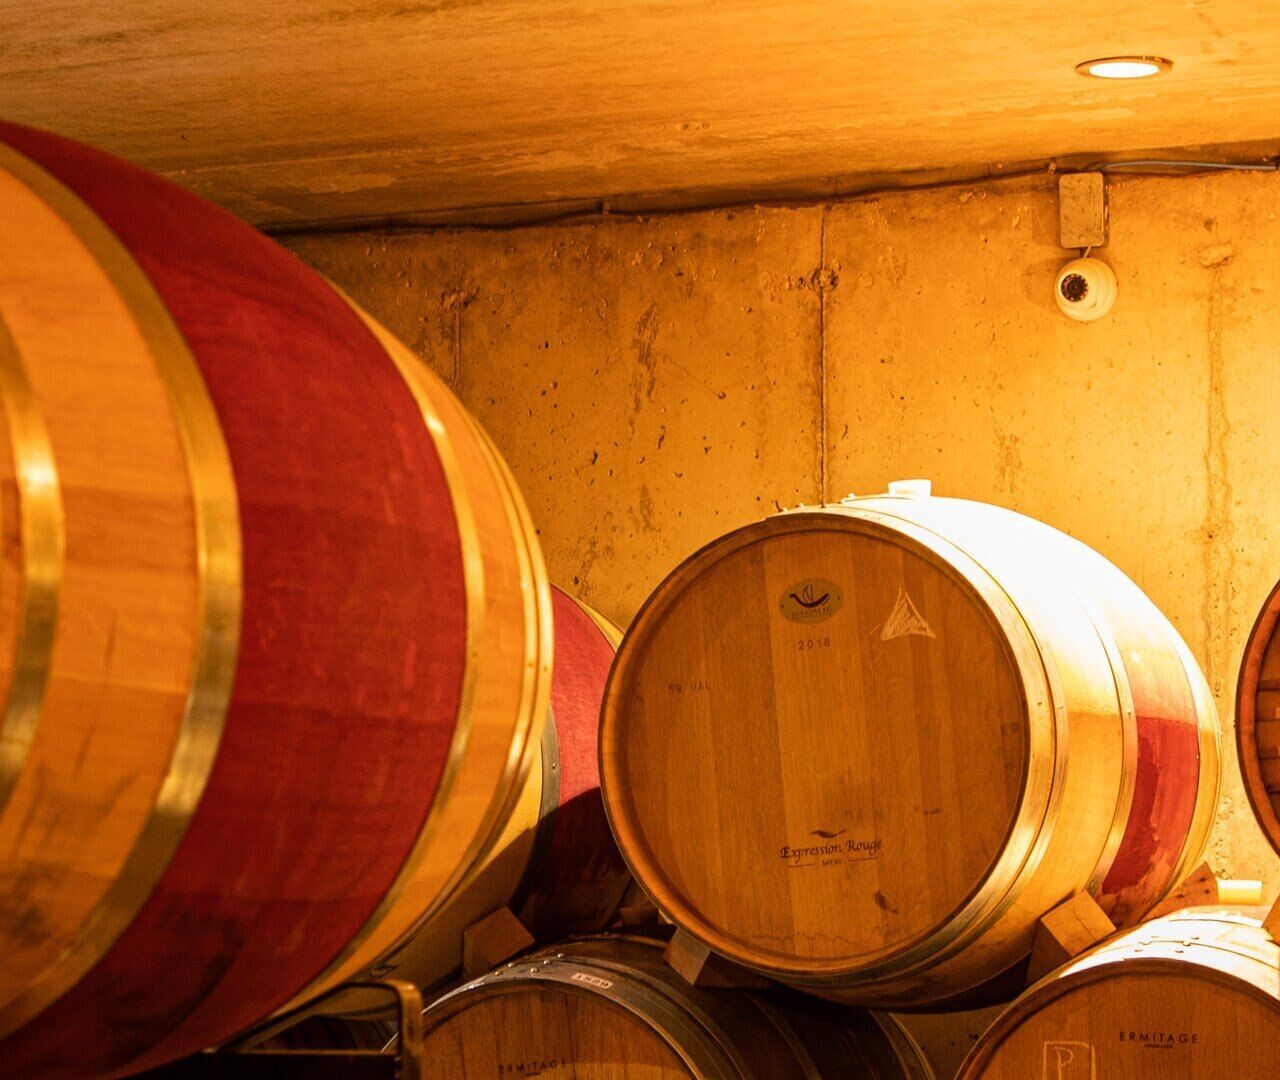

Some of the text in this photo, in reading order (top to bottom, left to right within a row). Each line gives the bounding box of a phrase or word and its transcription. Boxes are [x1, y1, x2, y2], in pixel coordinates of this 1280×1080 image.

[798, 637, 831, 651] 2018
[780, 839, 883, 863] Expression Rouge
[1119, 1031, 1199, 1045] ERMITAGE
[498, 1058, 567, 1074] ERMITAGE
